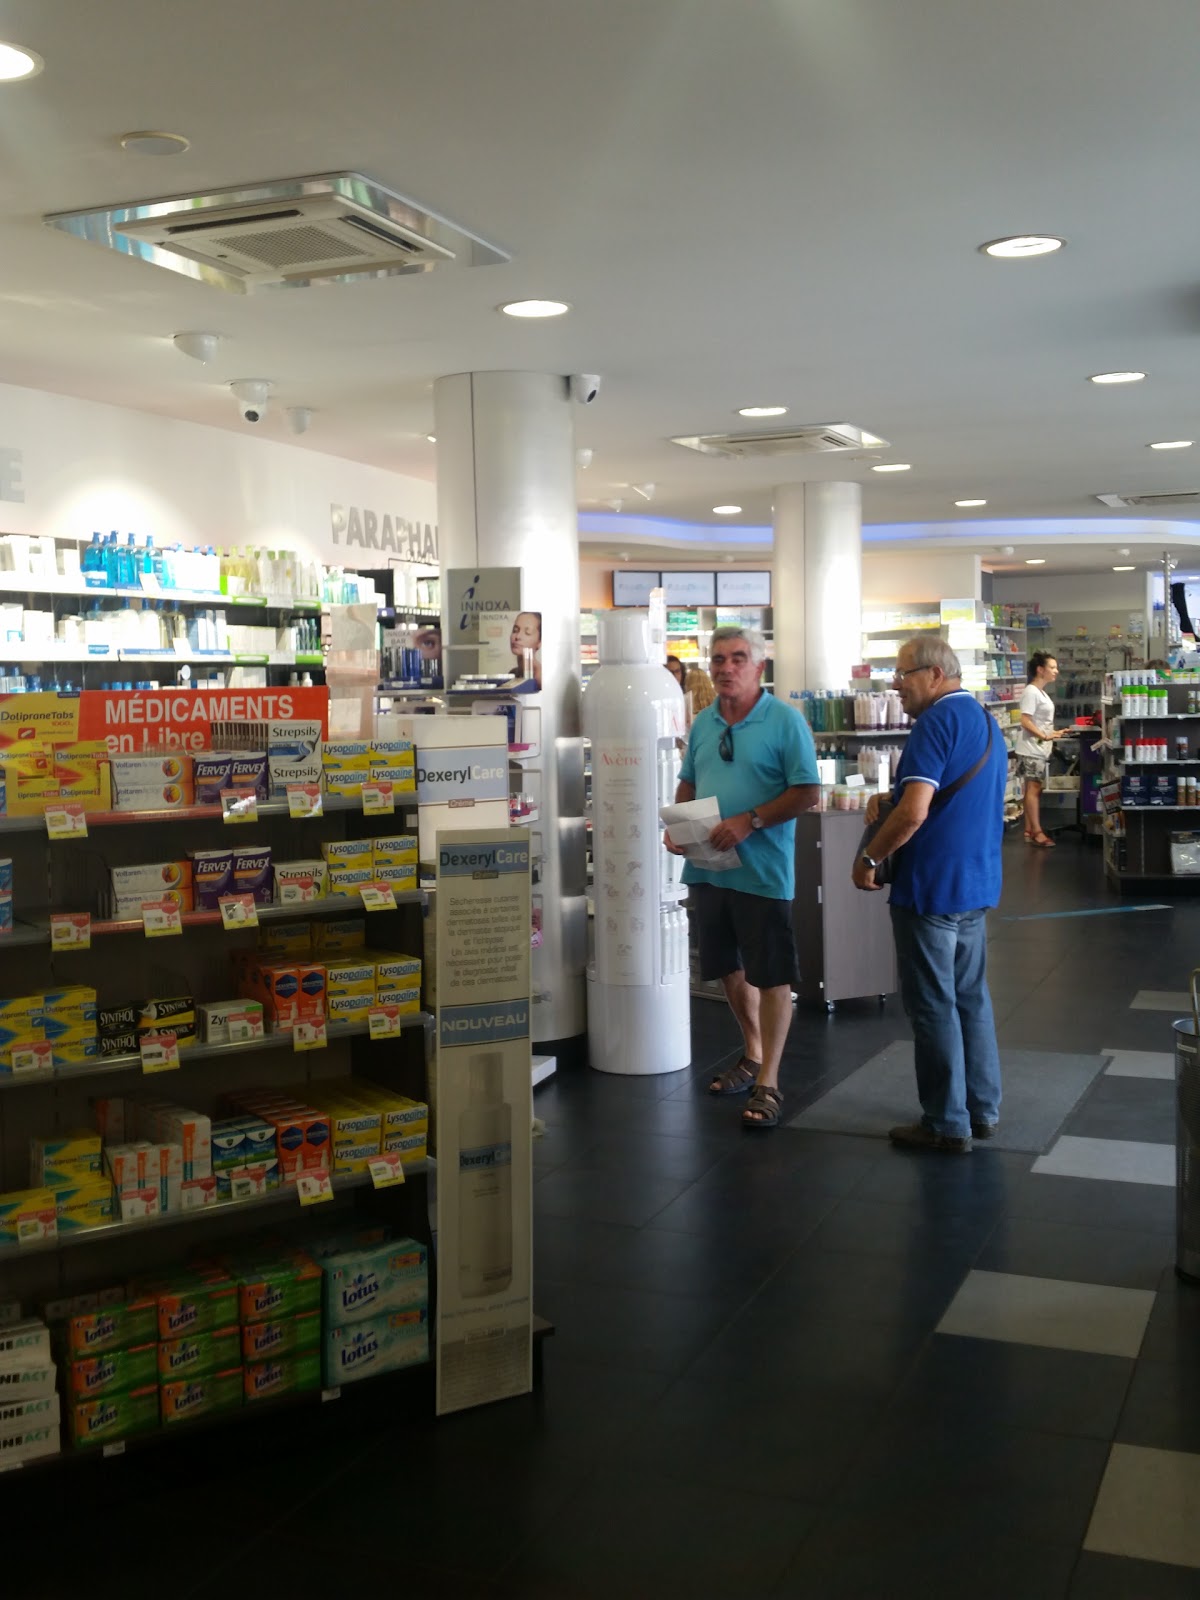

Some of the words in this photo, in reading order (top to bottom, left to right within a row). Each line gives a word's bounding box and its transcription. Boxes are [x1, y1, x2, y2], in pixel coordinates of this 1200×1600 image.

[461, 600, 511, 612] INNOXA
[105, 692, 294, 724] MÉDICAMENTS
[272, 726, 318, 738] Strepsils
[105, 733, 134, 753] en
[142, 727, 205, 753] Libre
[370, 739, 411, 752] Lysopaïne
[323, 742, 367, 755] Lysopaïne
[197, 763, 231, 776] FERVEX
[232, 762, 265, 774] FERVEX
[274, 767, 319, 778] Strepsils
[372, 767, 413, 780] Lysopaïne
[327, 770, 368, 784] Lysopaïne
[329, 841, 370, 855] Lysopaïne
[376, 838, 416, 851] Lysopaïne
[198, 860, 232, 872] FERVEX
[236, 857, 270, 869] FERVEX
[330, 870, 371, 884] Lysopaïne
[376, 864, 415, 879] Lysopaïne
[329, 968, 373, 982] Lysopaïne
[380, 962, 420, 977] Lysopaïne
[331, 995, 374, 1010] Lysopaïne
[378, 989, 419, 1005] Lysopaïne
[100, 1009, 136, 1026] SYNTHOL
[441, 1012, 527, 1032] NOUVEAU
[102, 1034, 137, 1051] SYNTHOL
[337, 1117, 380, 1132] Lysopaïne
[335, 1145, 378, 1160] Lysopaïne
[255, 1292, 284, 1311] lotus
[342, 1280, 379, 1308] lotus
[168, 1310, 198, 1329] lotus
[85, 1323, 116, 1343] lotus
[170, 1348, 200, 1368] lotus
[341, 1339, 379, 1366] lotus
[86, 1366, 116, 1386] lotus
[175, 1390, 205, 1410] lotus
[88, 1409, 118, 1431] lotus
